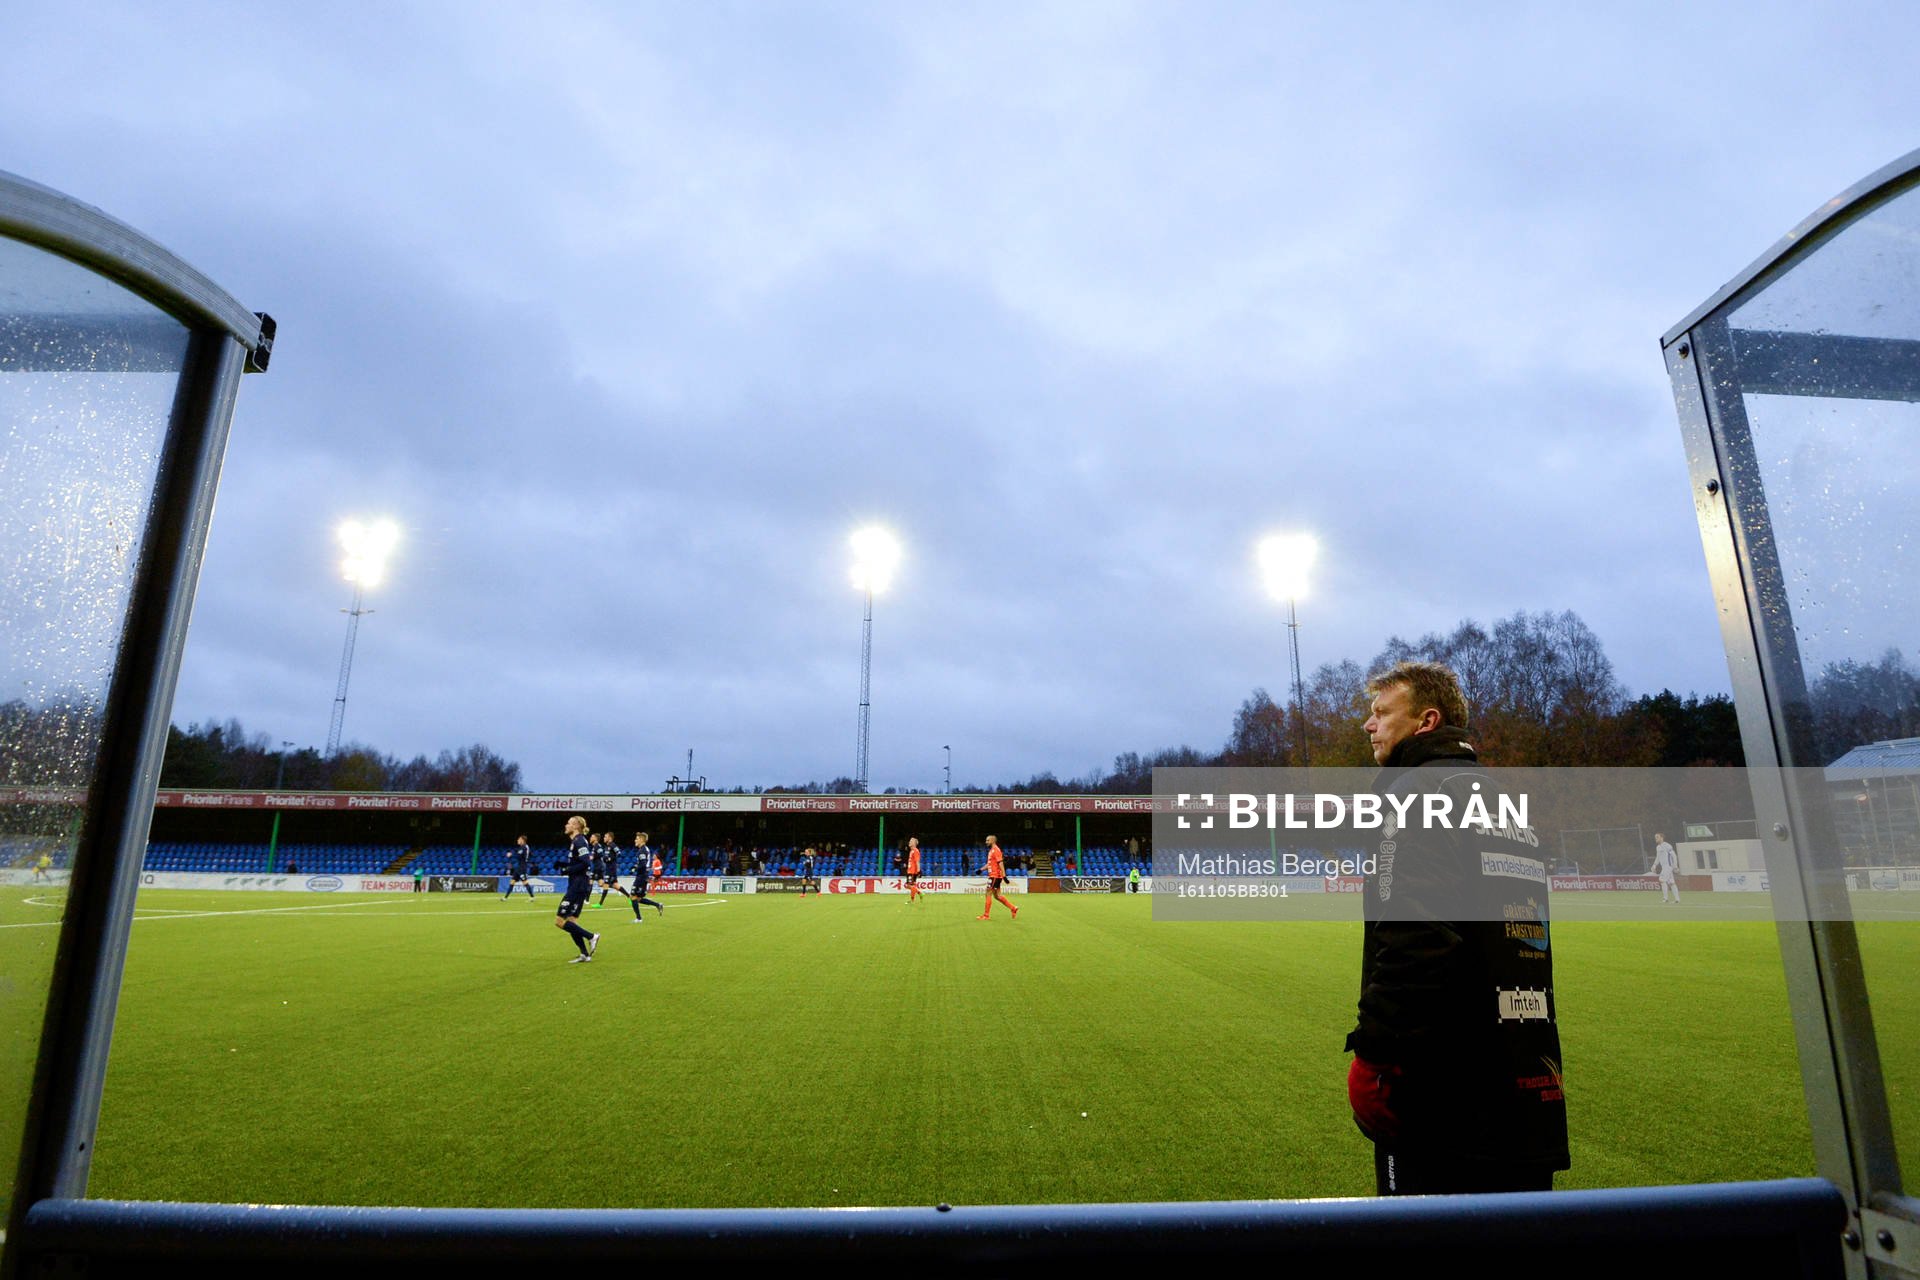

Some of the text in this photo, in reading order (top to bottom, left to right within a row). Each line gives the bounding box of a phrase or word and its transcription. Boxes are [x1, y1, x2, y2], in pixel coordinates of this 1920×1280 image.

[521, 797, 613, 809] Prioritet Finans
[631, 798, 720, 809] Prioritet Finans
[767, 799, 806, 809] Prioritet
[849, 799, 889, 809] Prioritet
[932, 799, 971, 809] Prioritet
[1013, 800, 1052, 810] Prioritet
[1094, 800, 1133, 810] Prioritet
[1482, 855, 1545, 879] Handelsbanken
[360, 880, 385, 890] TEAM
[455, 881, 488, 889] BULLDOG
[677, 881, 704, 891] Finans
[829, 878, 882, 894] GT
